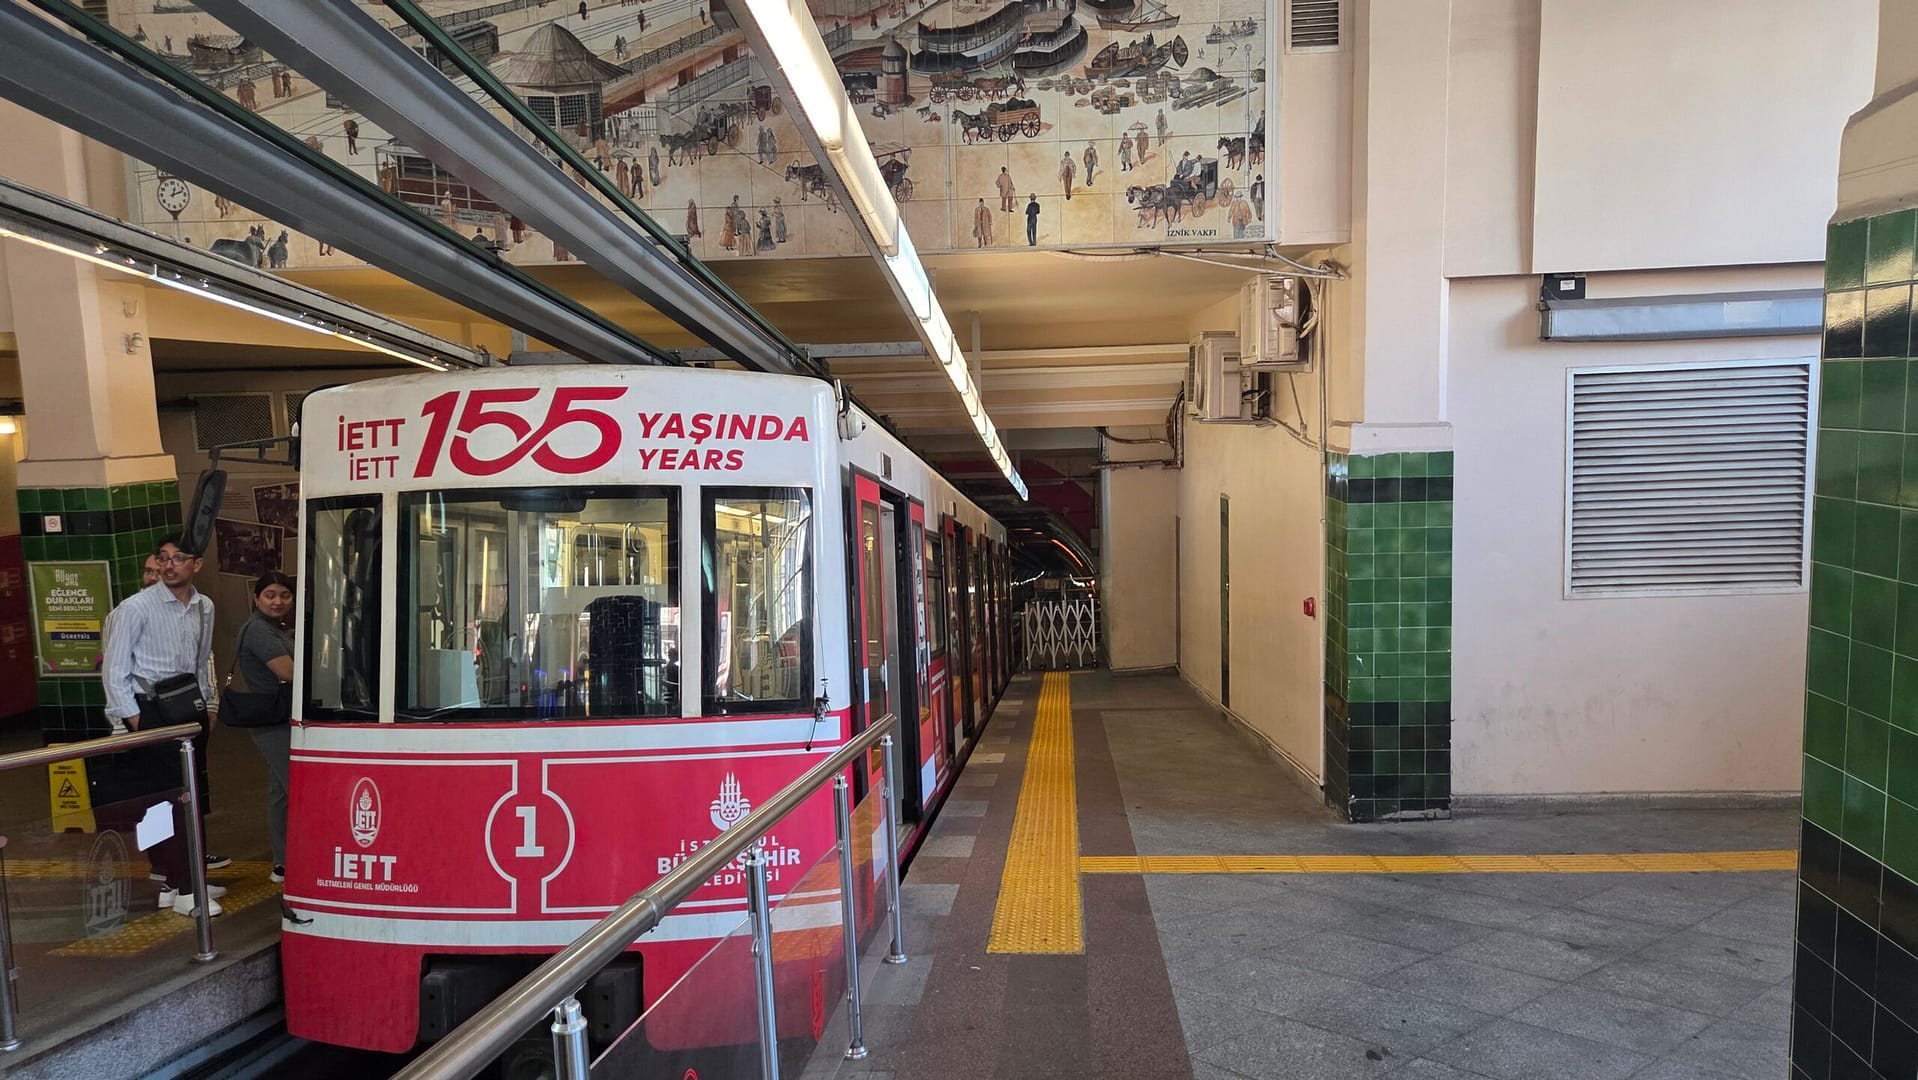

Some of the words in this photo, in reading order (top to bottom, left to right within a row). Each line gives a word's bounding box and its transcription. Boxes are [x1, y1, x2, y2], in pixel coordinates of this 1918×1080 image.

[338, 415, 405, 451] İETT
[413, 387, 628, 478] 155
[638, 412, 809, 445] YAŞINDA
[349, 453, 399, 481] İETT
[638, 448, 744, 471] YEARS
[45, 596, 94, 605] DURAKLARI
[51, 587, 88, 597] EĞLENCE
[516, 806, 544, 857] 1
[334, 846, 397, 881] İETT
[353, 882, 374, 891] GENEL
[375, 883, 419, 893] MÜDÜRLÜĞÜ
